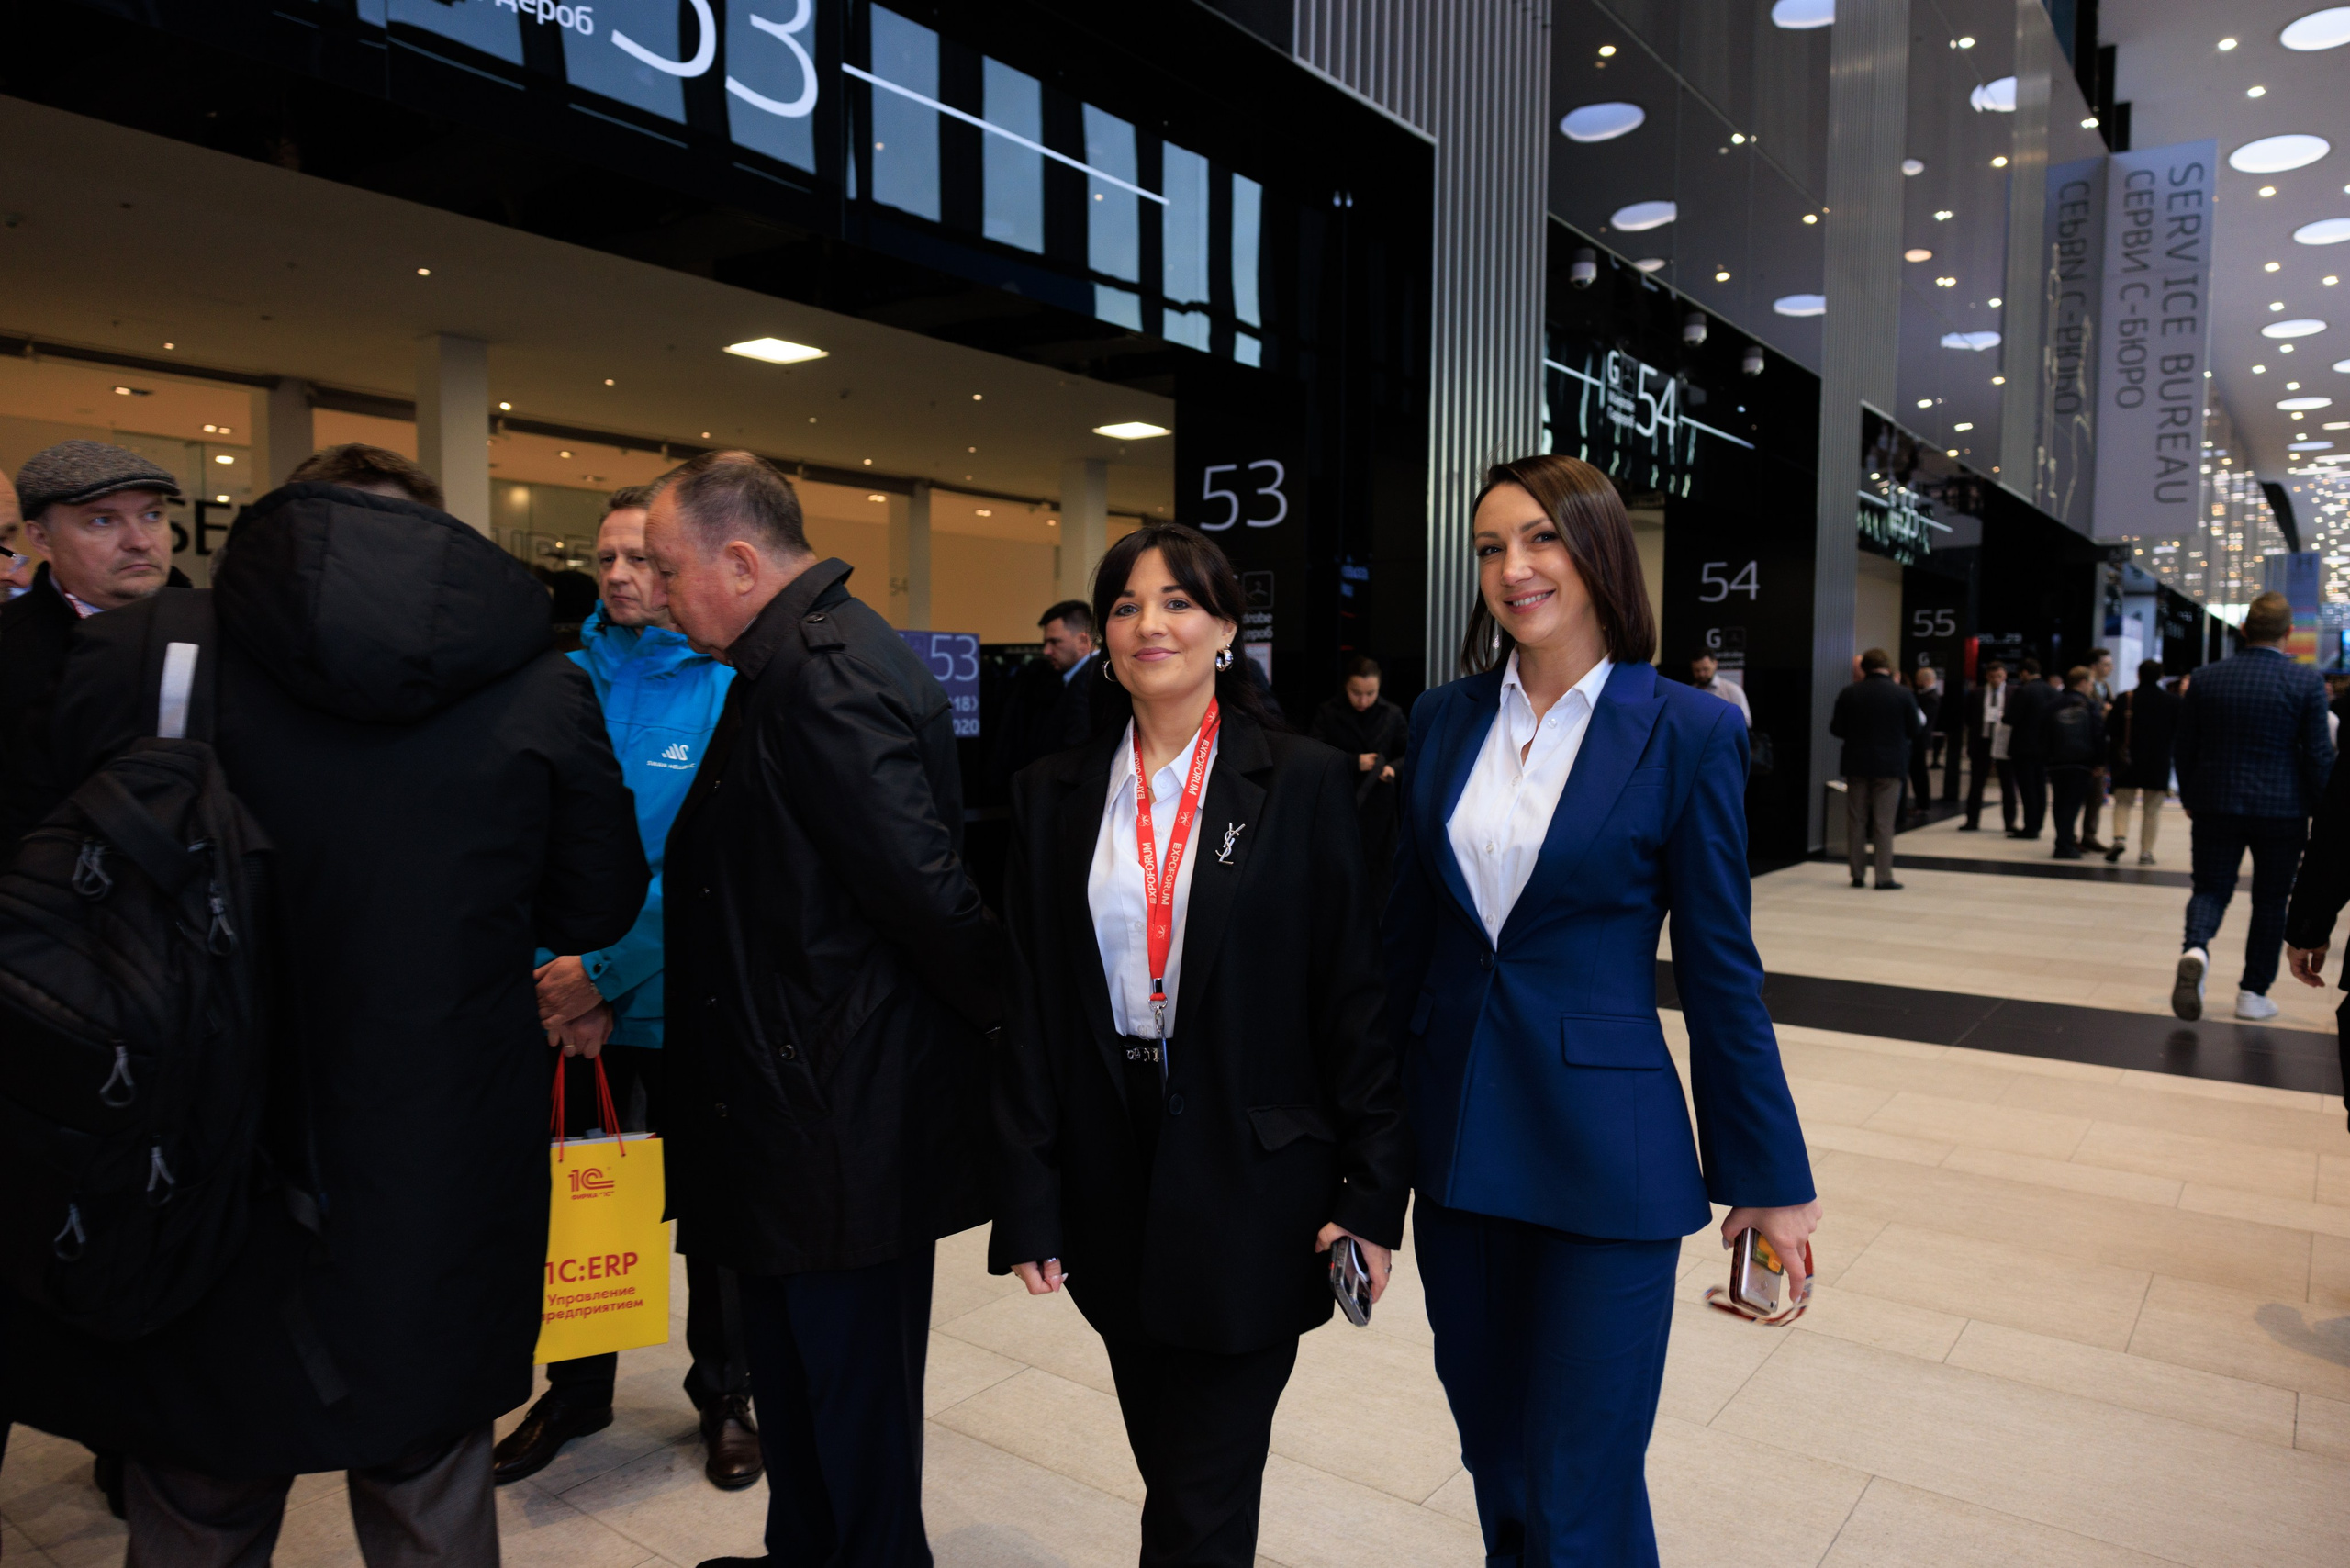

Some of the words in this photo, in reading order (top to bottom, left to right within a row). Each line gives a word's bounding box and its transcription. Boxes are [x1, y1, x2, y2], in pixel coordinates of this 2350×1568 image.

[1607, 350, 1620, 385] G
[1636, 363, 1676, 445] 54
[2154, 353, 2195, 504] BUREAU
[1200, 459, 1288, 531] 53
[167, 497, 252, 556] SE
[1699, 560, 1761, 602] 54
[1706, 628, 1721, 648] G
[1912, 609, 1956, 637] 55
[931, 634, 979, 681] 53
[1188, 739, 1210, 796] EXPOFORUM
[1142, 842, 1158, 904] EXPOFORUM
[1161, 842, 1182, 906] EXPOFORUM
[545, 1251, 638, 1285] 1C:ERP
[547, 1286, 635, 1308] Управление
